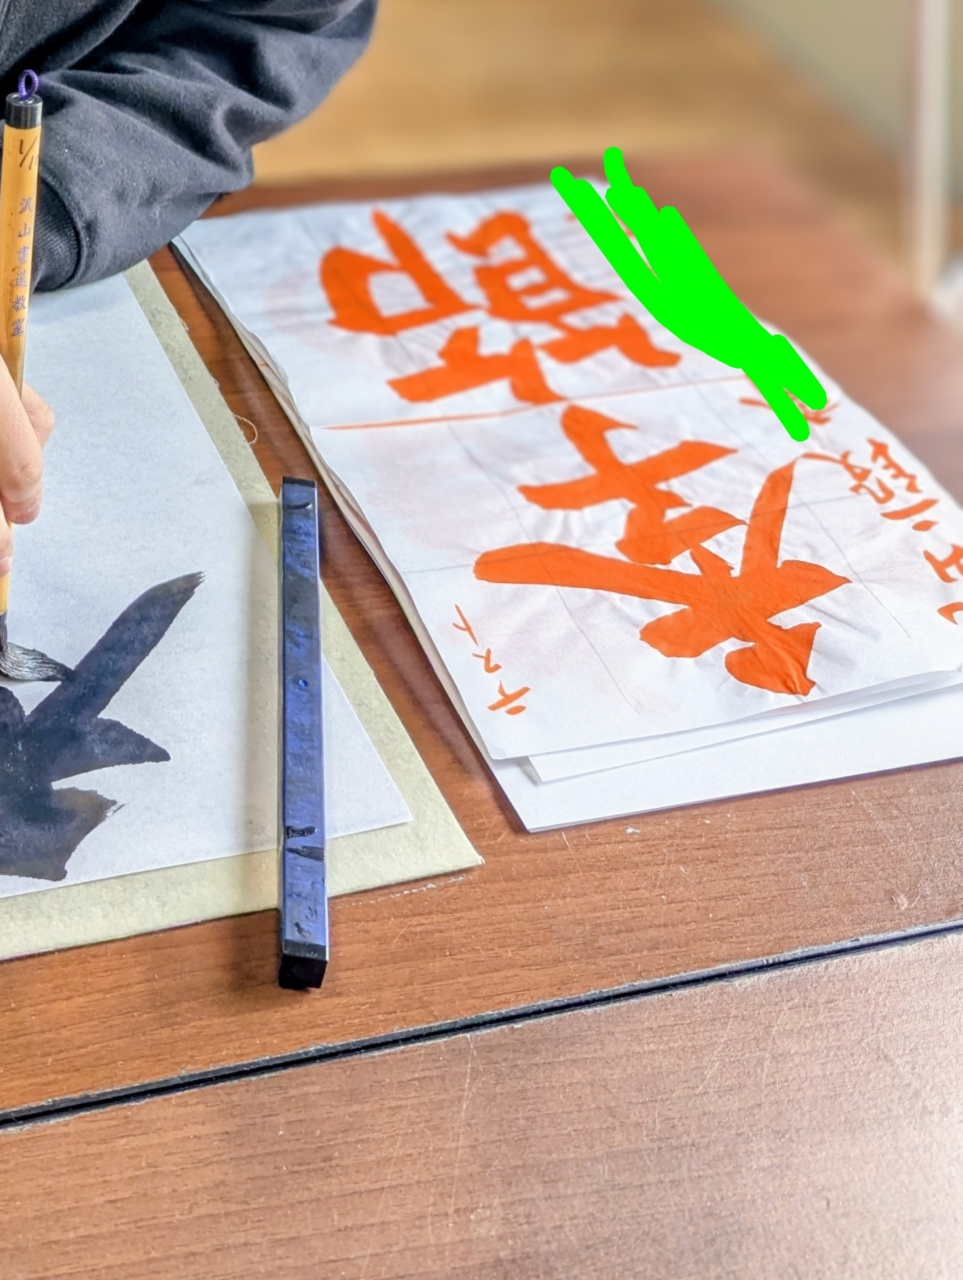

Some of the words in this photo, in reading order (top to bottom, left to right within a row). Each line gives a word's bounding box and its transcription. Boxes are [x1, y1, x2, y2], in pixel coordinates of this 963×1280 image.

[320, 210, 850, 696] 季節
[452, 604, 531, 715] テスト
